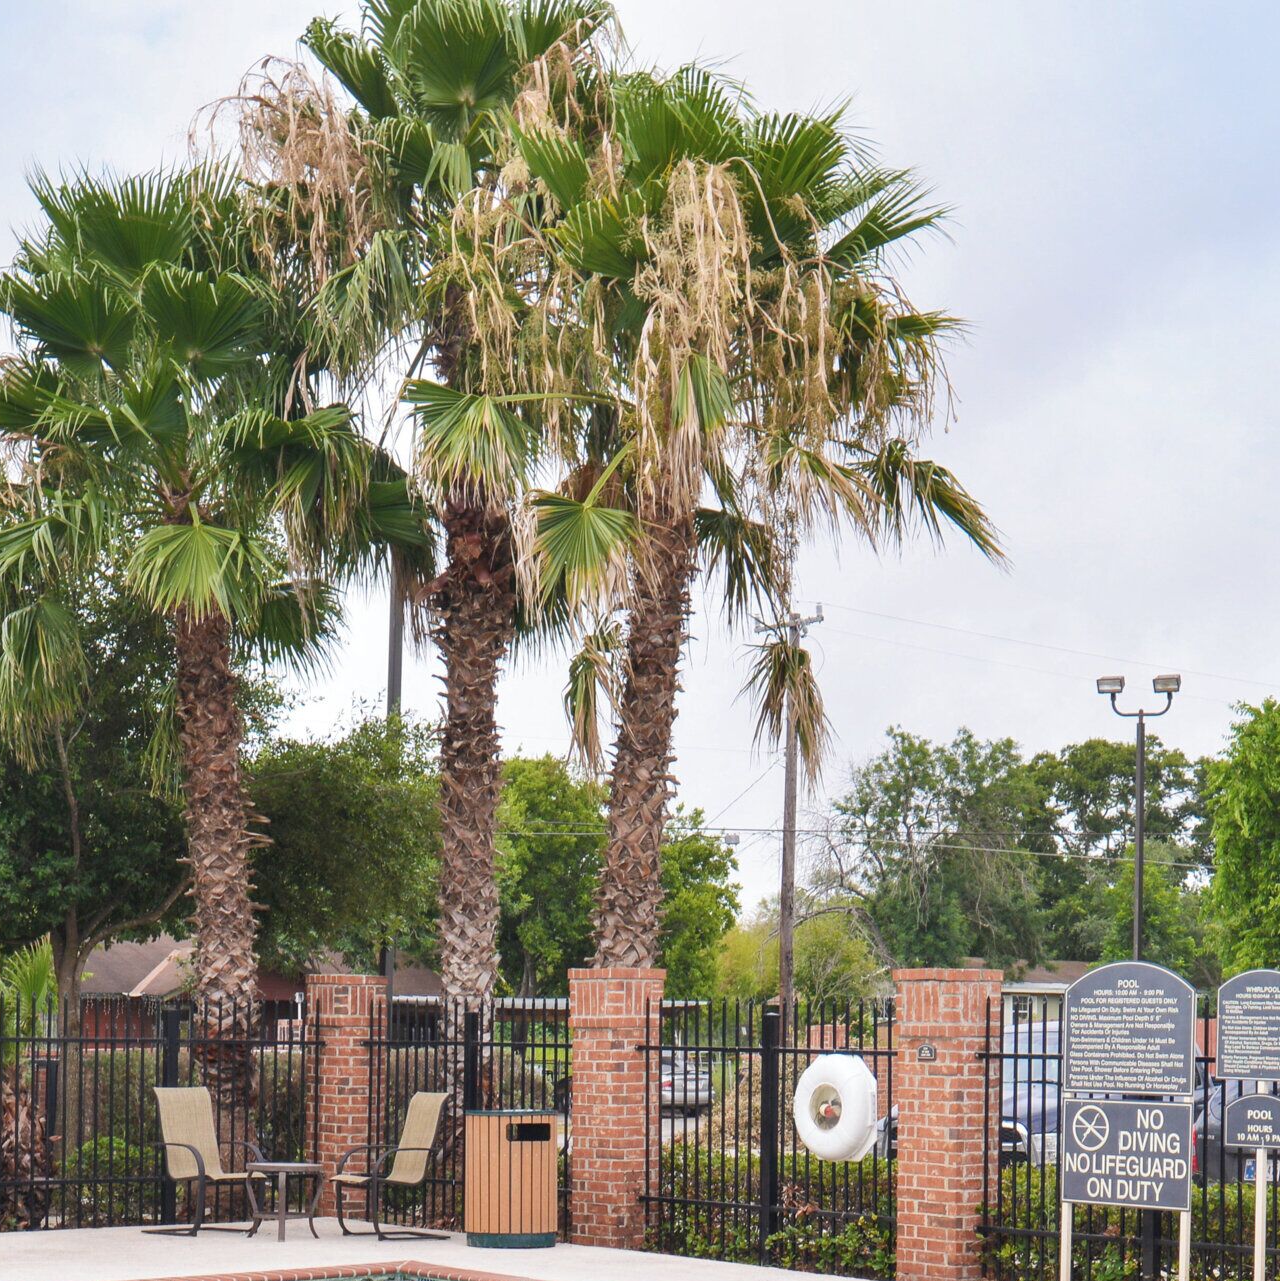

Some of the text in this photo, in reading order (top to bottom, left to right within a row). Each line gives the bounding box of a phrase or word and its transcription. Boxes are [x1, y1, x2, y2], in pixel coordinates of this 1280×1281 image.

[1118, 980, 1140, 988] POOL
[1137, 1109, 1164, 1130] NO
[1248, 1110, 1273, 1120] POOL
[1248, 1124, 1272, 1133] HOURS
[1119, 1131, 1180, 1154] DIVING
[1066, 1153, 1186, 1179] NO LIFEGUARD
[1087, 1178, 1164, 1202] ON DUTY
